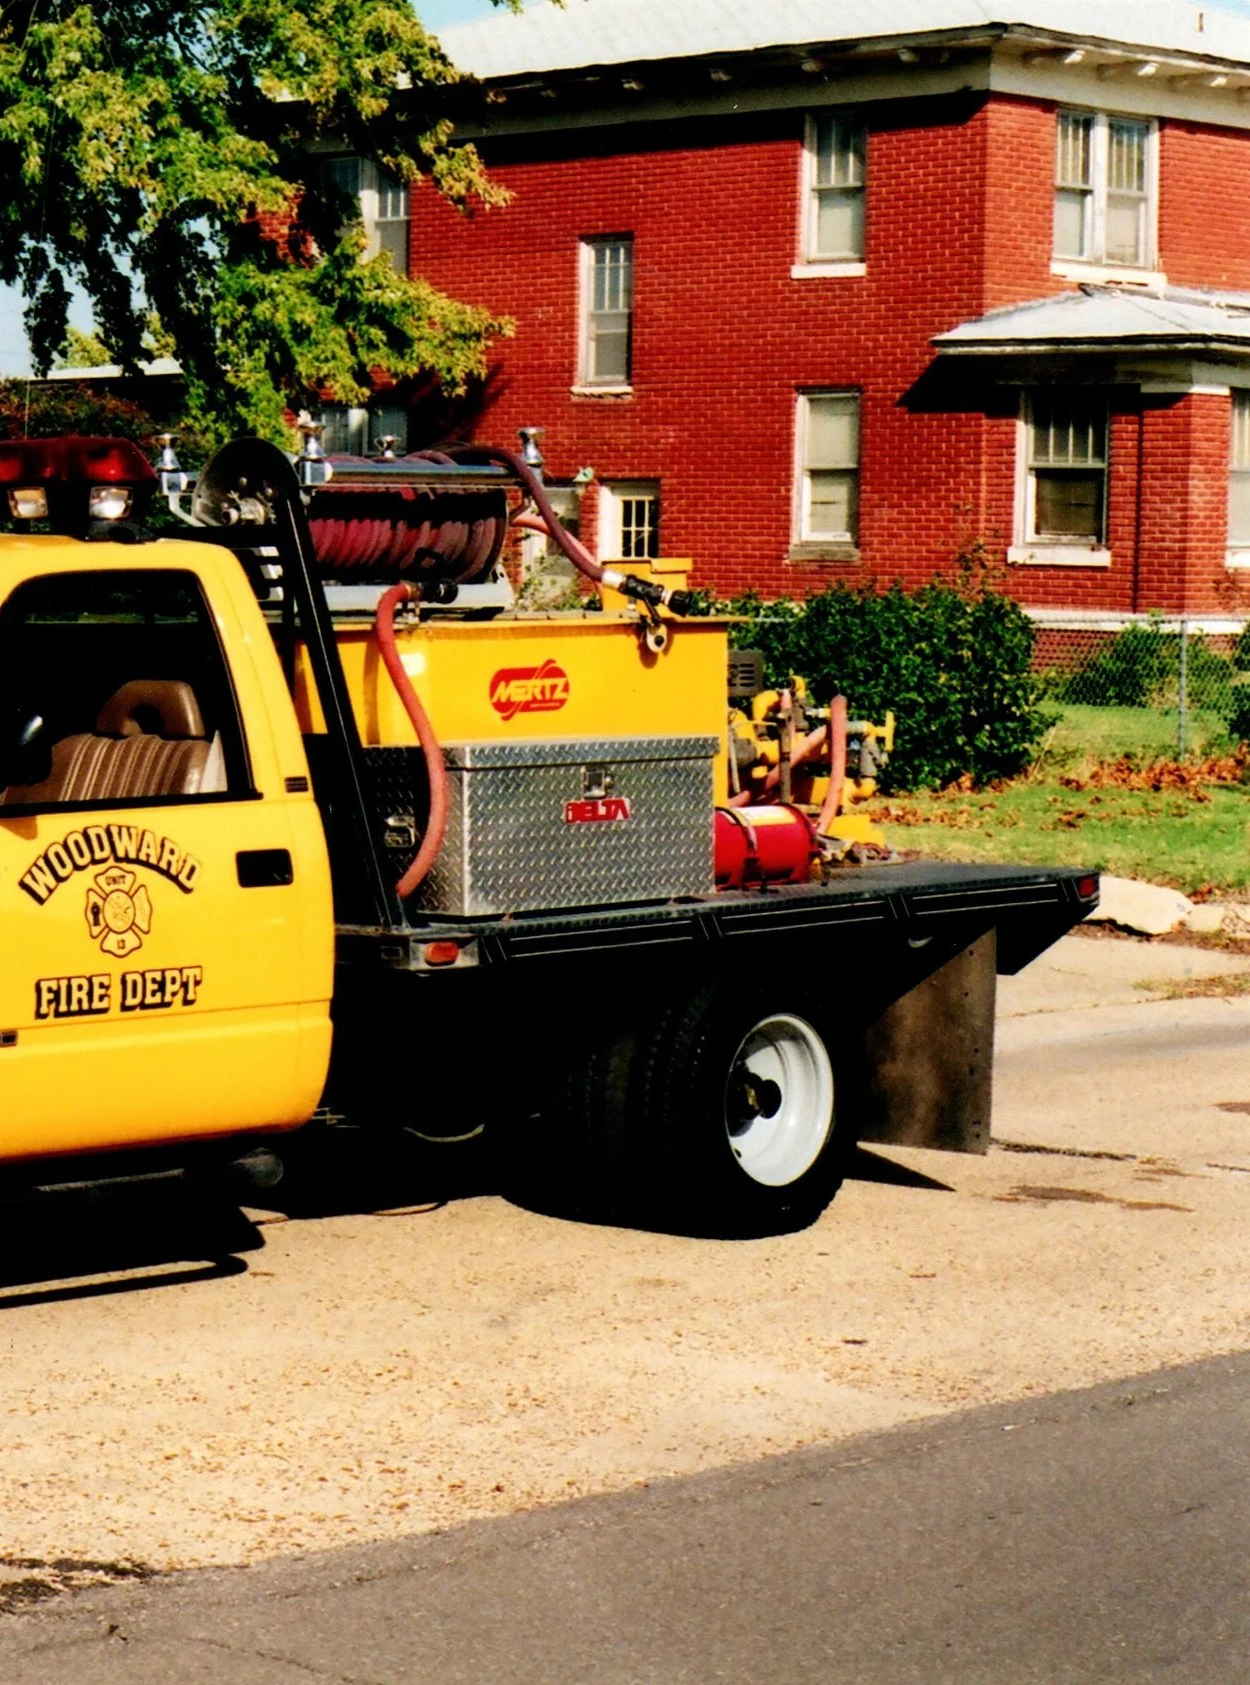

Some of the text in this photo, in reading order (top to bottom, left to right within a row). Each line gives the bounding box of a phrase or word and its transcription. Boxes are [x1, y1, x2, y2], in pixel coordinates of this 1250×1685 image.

[491, 677, 568, 702] MERTZ
[566, 798, 629, 823] DELTA
[18, 824, 202, 905] WOODWARD
[105, 874, 127, 886] UNIT
[117, 939, 126, 950] 13
[35, 965, 202, 1020] FIRE DEPT
